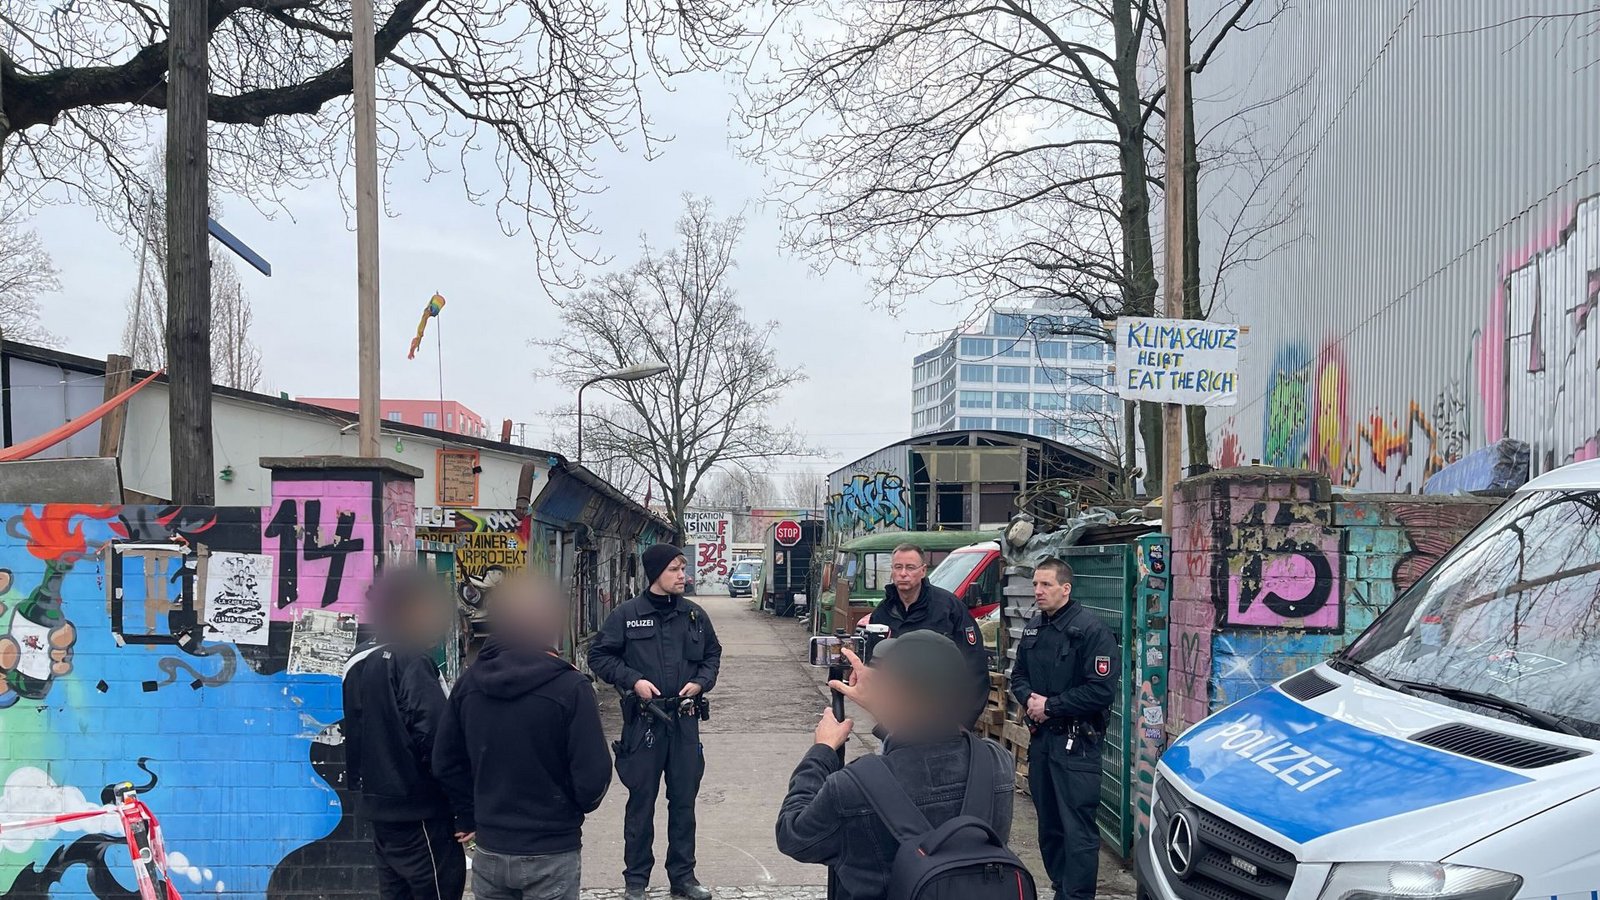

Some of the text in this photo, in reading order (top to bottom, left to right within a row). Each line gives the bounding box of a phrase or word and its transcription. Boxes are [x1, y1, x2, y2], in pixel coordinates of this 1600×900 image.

[1128, 321, 1237, 350] KLIMASCHUTZ
[1128, 369, 1165, 390] EAT
[778, 528, 798, 538] STOP
[264, 498, 363, 608] 14
[626, 619, 654, 628] POLIZEI
[1205, 722, 1343, 792] POLIZEI
